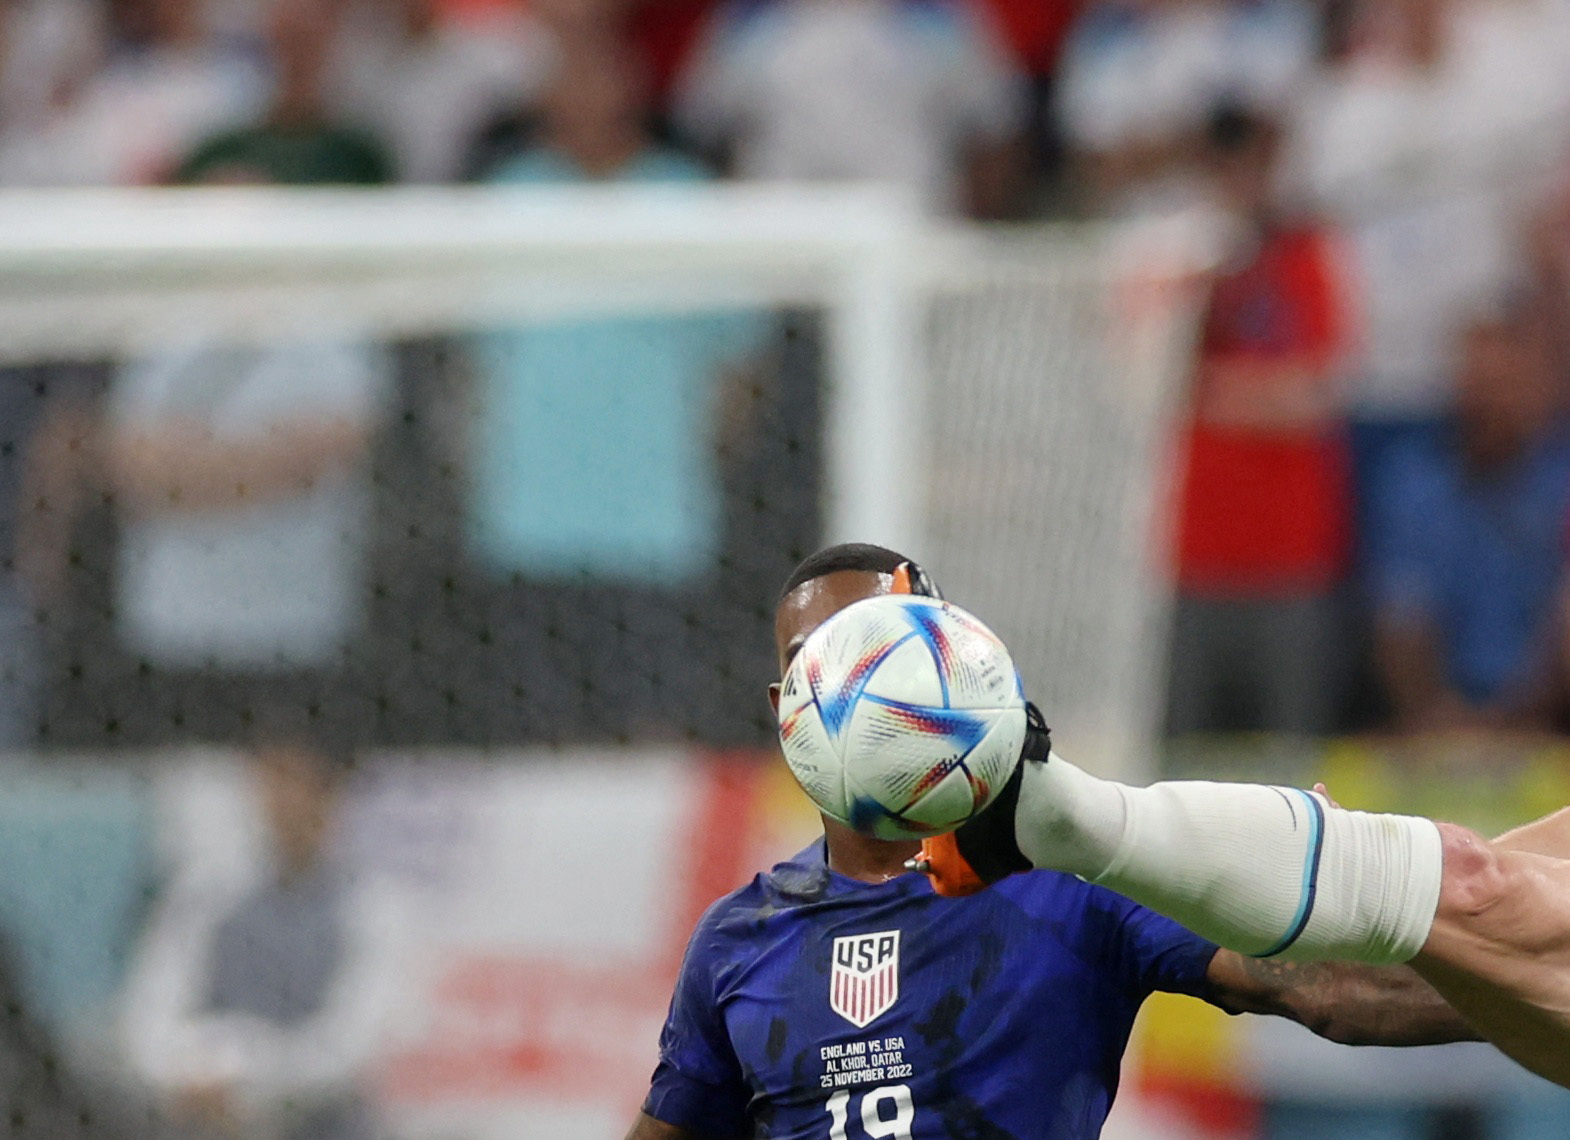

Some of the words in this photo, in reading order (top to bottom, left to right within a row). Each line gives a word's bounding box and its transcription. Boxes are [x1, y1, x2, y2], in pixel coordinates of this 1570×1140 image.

[837, 936, 894, 974] USA
[820, 1042, 866, 1061] ENGLAND
[868, 1040, 884, 1053] VS.
[884, 1037, 905, 1051] USA
[826, 1060, 840, 1073] AL
[841, 1056, 870, 1071] KHOR,
[871, 1051, 903, 1067] QATAR
[820, 1074, 833, 1088] 25
[834, 1067, 885, 1087] NOVEMBER
[886, 1063, 913, 1079] 2022
